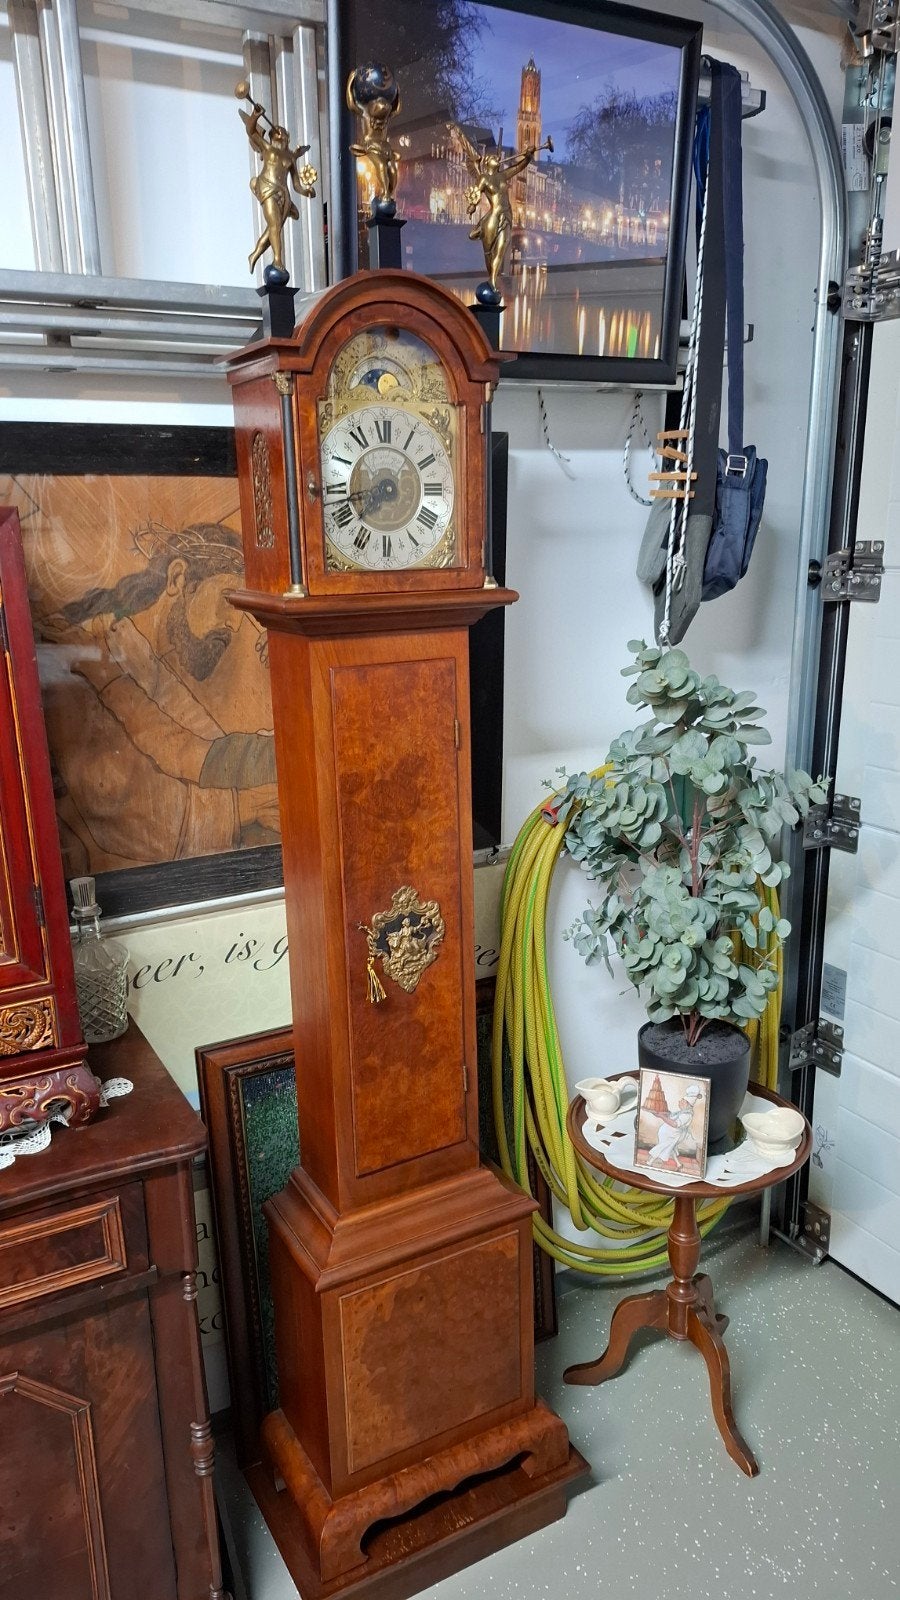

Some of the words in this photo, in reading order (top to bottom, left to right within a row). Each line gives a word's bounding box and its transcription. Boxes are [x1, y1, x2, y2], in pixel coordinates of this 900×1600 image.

[374, 420, 392, 444] XII
[403, 430, 415, 450] I
[417, 453, 436, 471] II
[424, 482, 443, 496] III
[416, 505, 439, 531] IIII
[382, 535, 395, 558] VI
[125, 952, 205, 998] eer,
[224, 932, 265, 964] is
